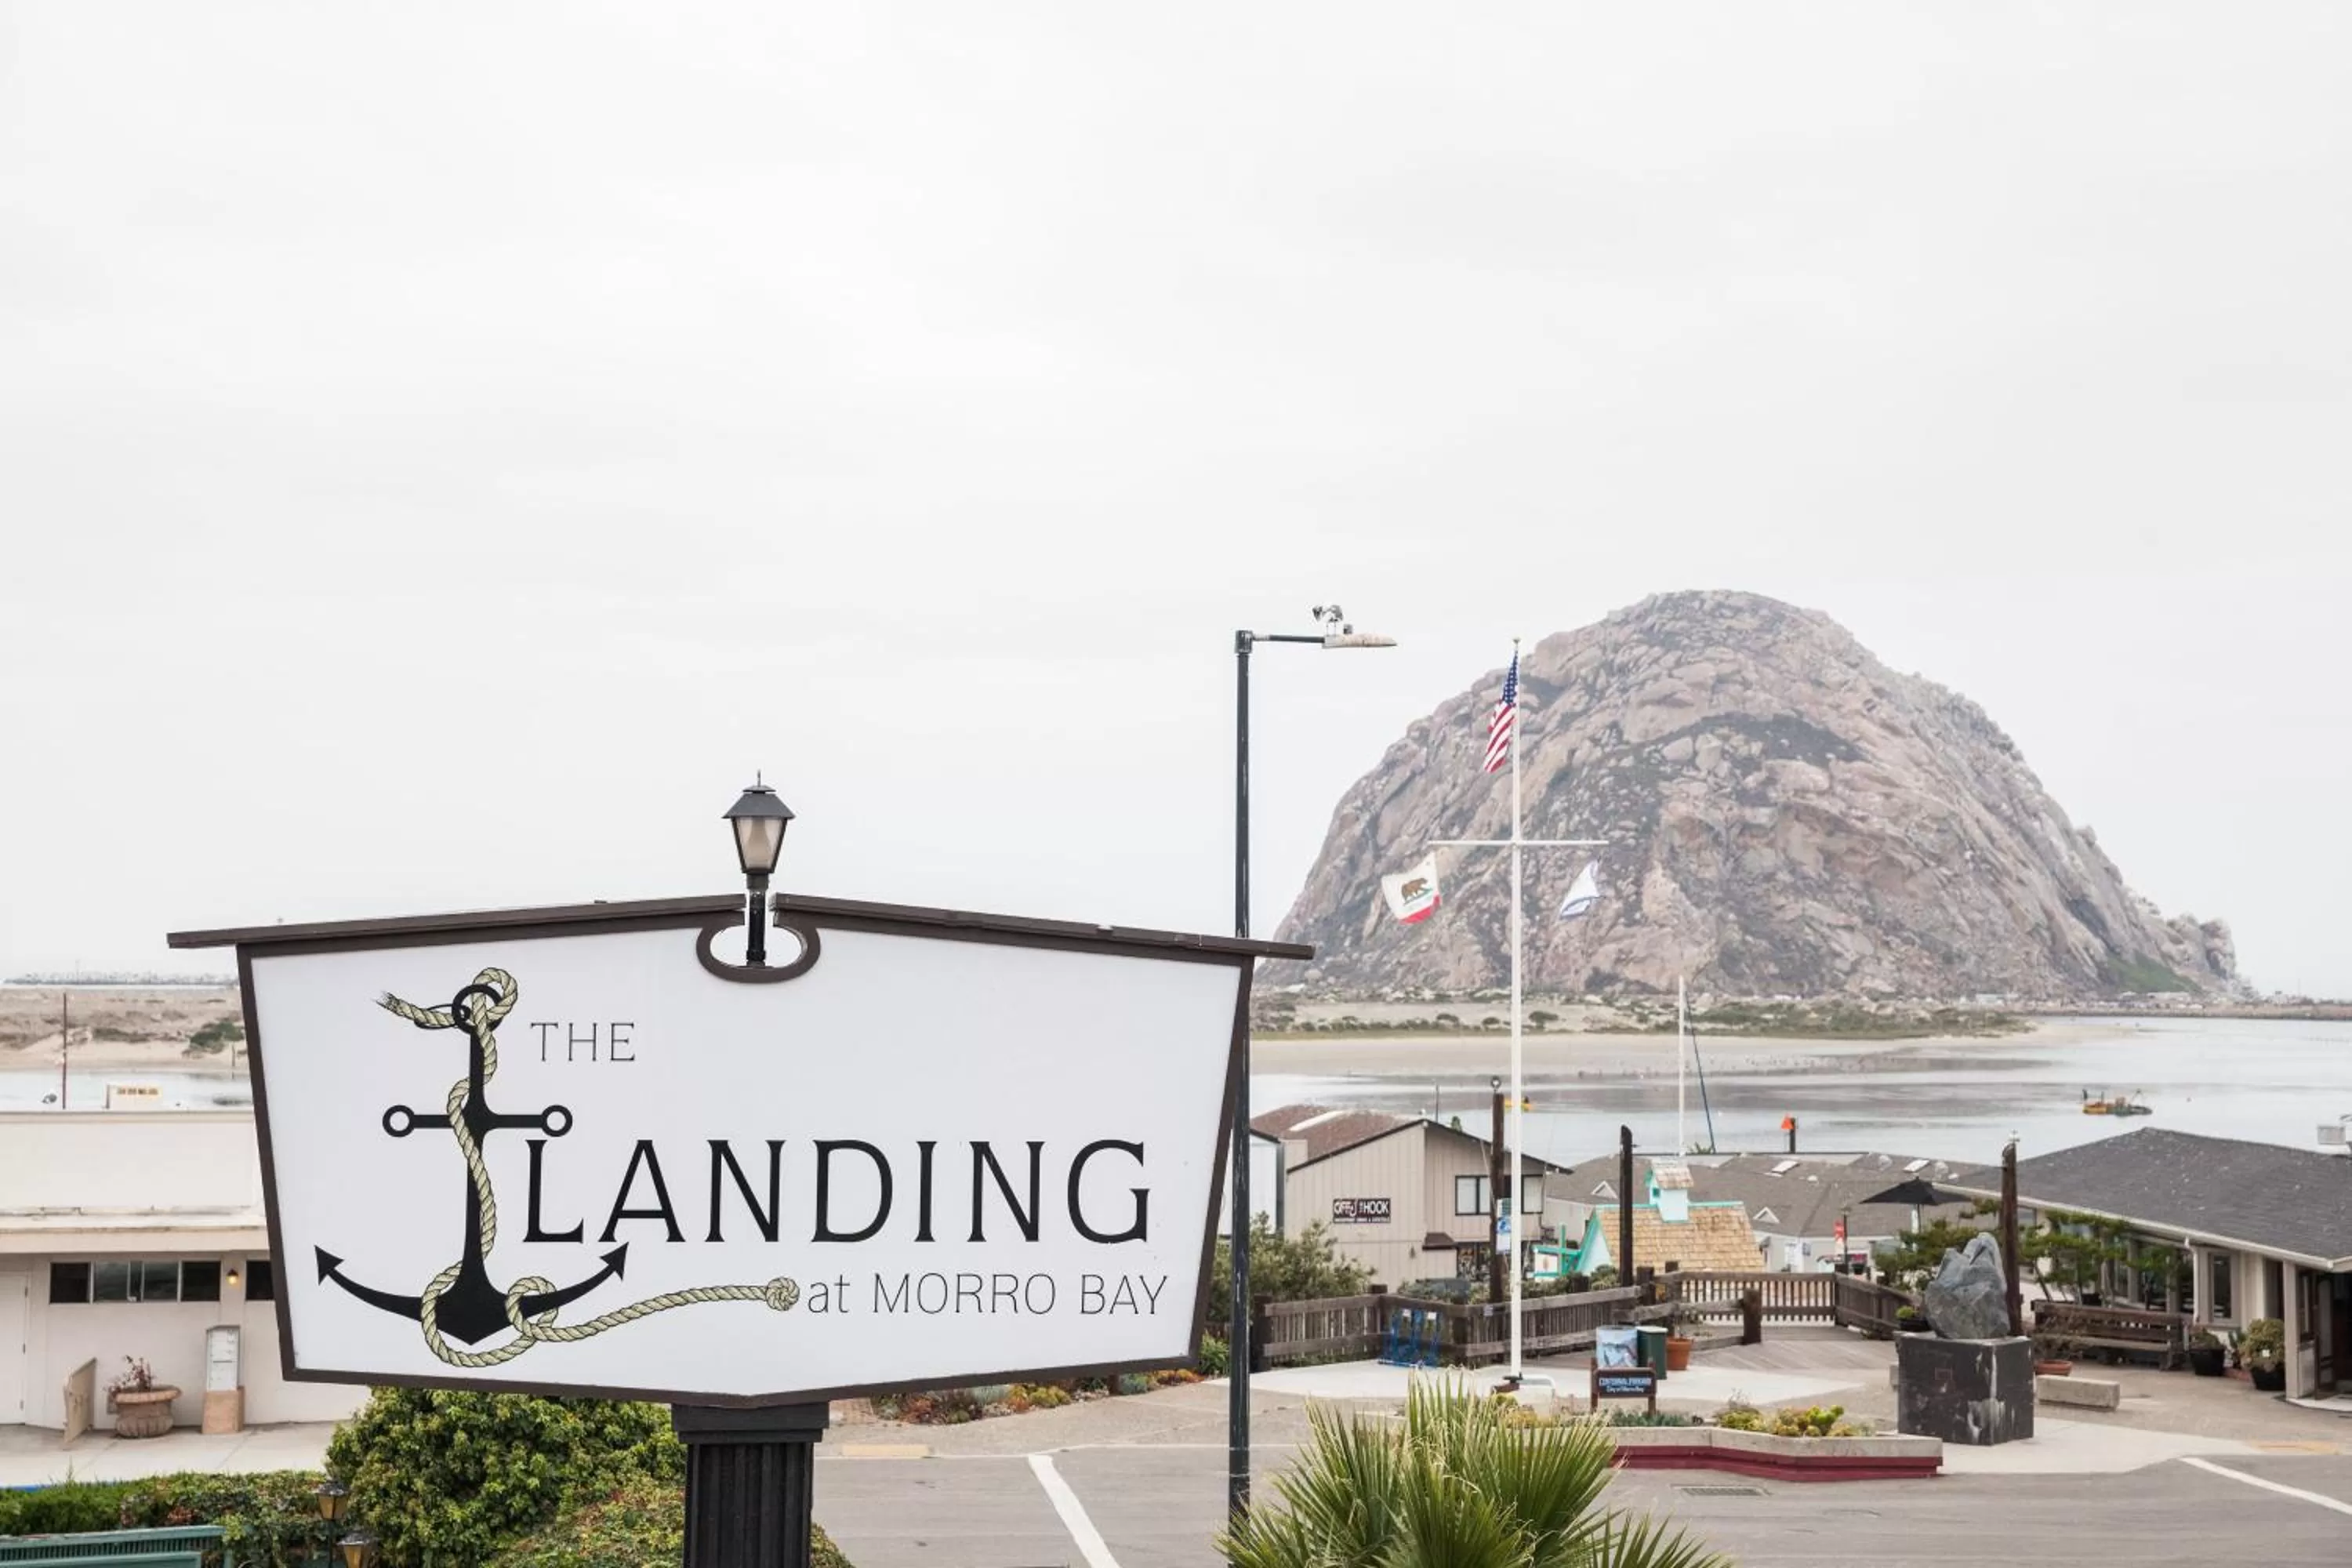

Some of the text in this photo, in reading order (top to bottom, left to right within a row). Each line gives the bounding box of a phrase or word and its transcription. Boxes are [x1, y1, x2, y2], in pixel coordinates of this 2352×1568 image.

[531, 1022, 636, 1062] THE
[523, 1140, 1150, 1244] LANDING
[1363, 1200, 1388, 1214] HOOK
[808, 1272, 1167, 1315] at MORRO BAY
